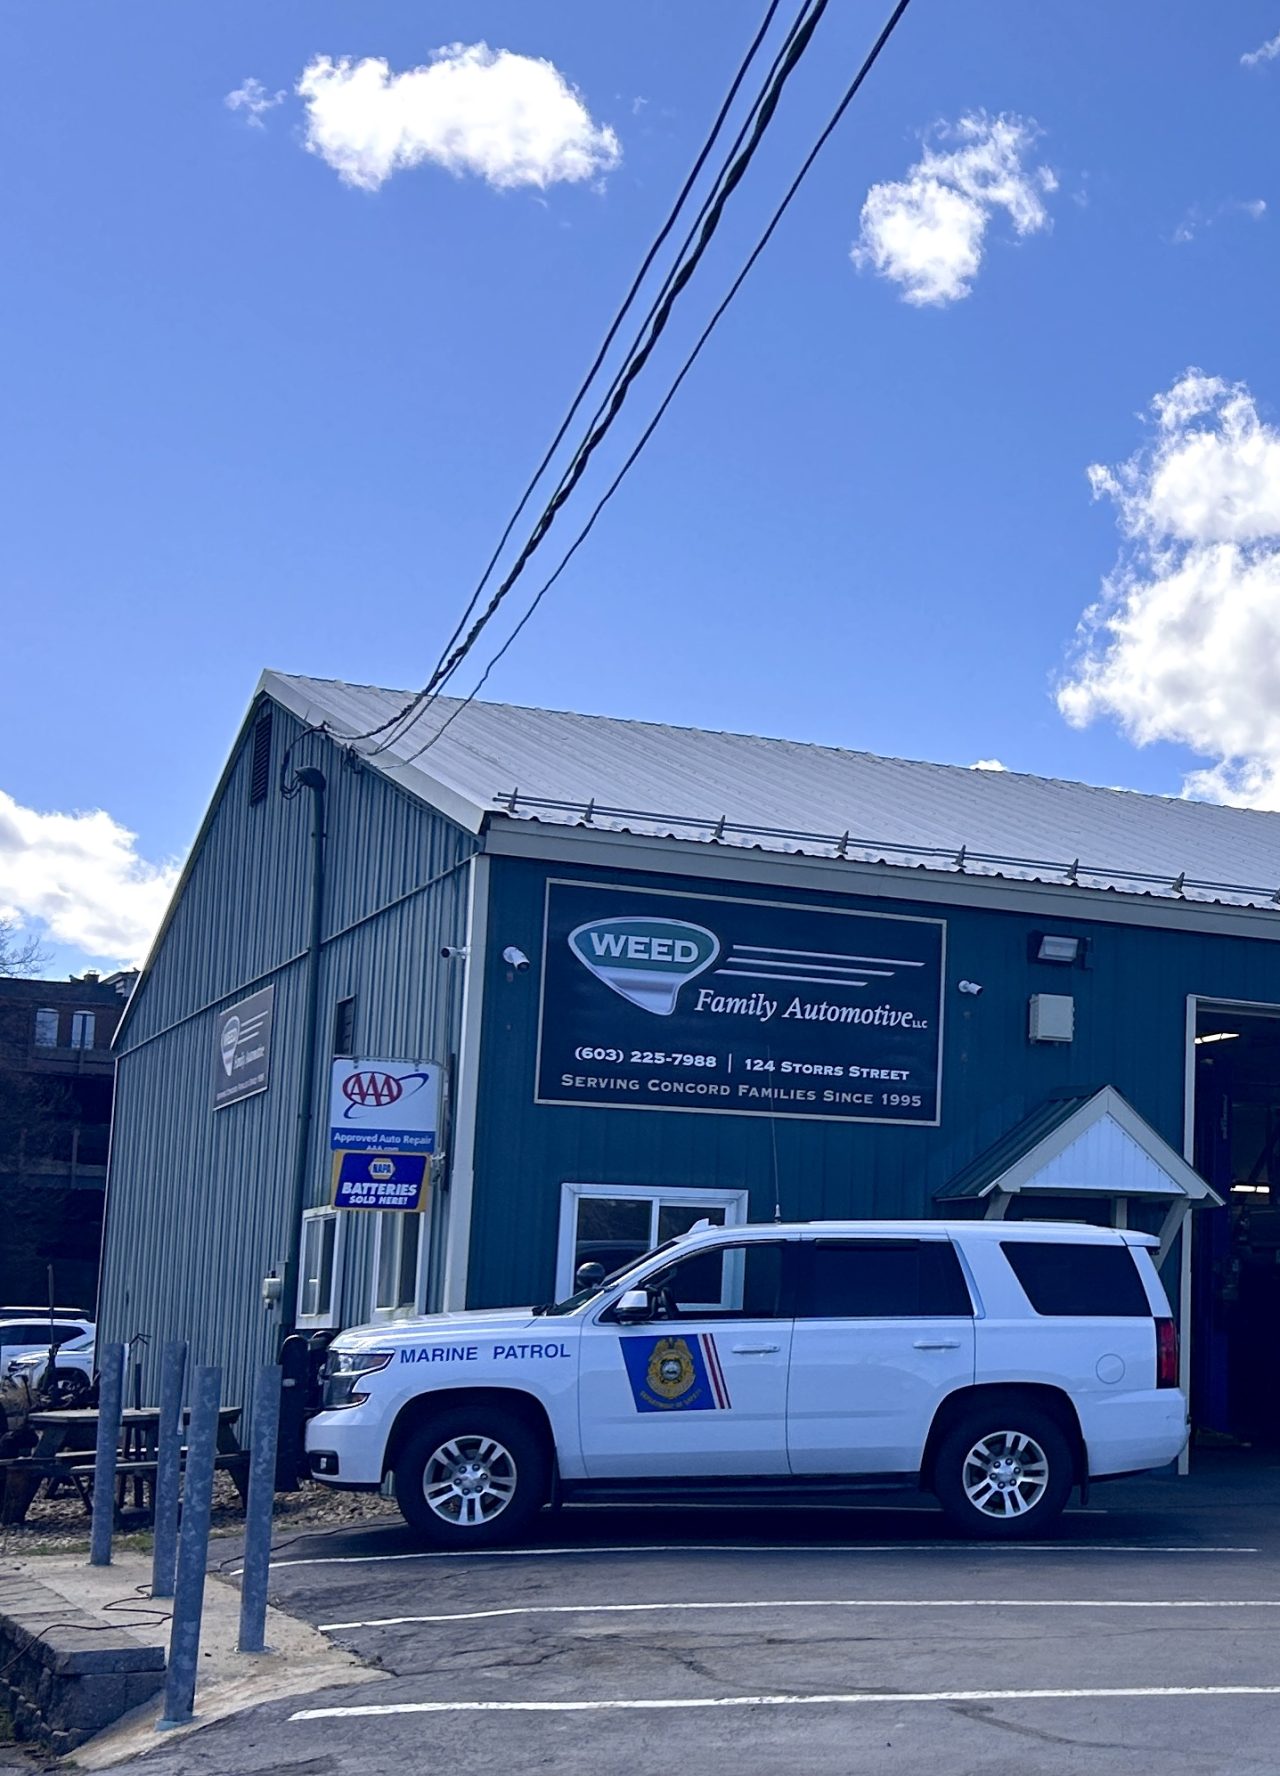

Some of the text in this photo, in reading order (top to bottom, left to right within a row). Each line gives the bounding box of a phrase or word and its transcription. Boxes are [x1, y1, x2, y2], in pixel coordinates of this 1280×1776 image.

[590, 932, 699, 963] WEED
[694, 988, 928, 1029] Family Automotive LLC
[574, 1046, 717, 1068] (603) 225-7988
[745, 1058, 910, 1081] 124 STORRS STREET
[350, 1073, 397, 1106] AAA
[561, 1074, 922, 1107] SERVING CONCORD FAMILIES SINCE 1995
[333, 1132, 433, 1146] Approved Auto Repair
[373, 1163, 391, 1173] NAPA
[341, 1182, 417, 1197] BATTERIES
[349, 1195, 408, 1205] SOLD HERE!
[400, 1343, 571, 1364] MARINE PATROL
